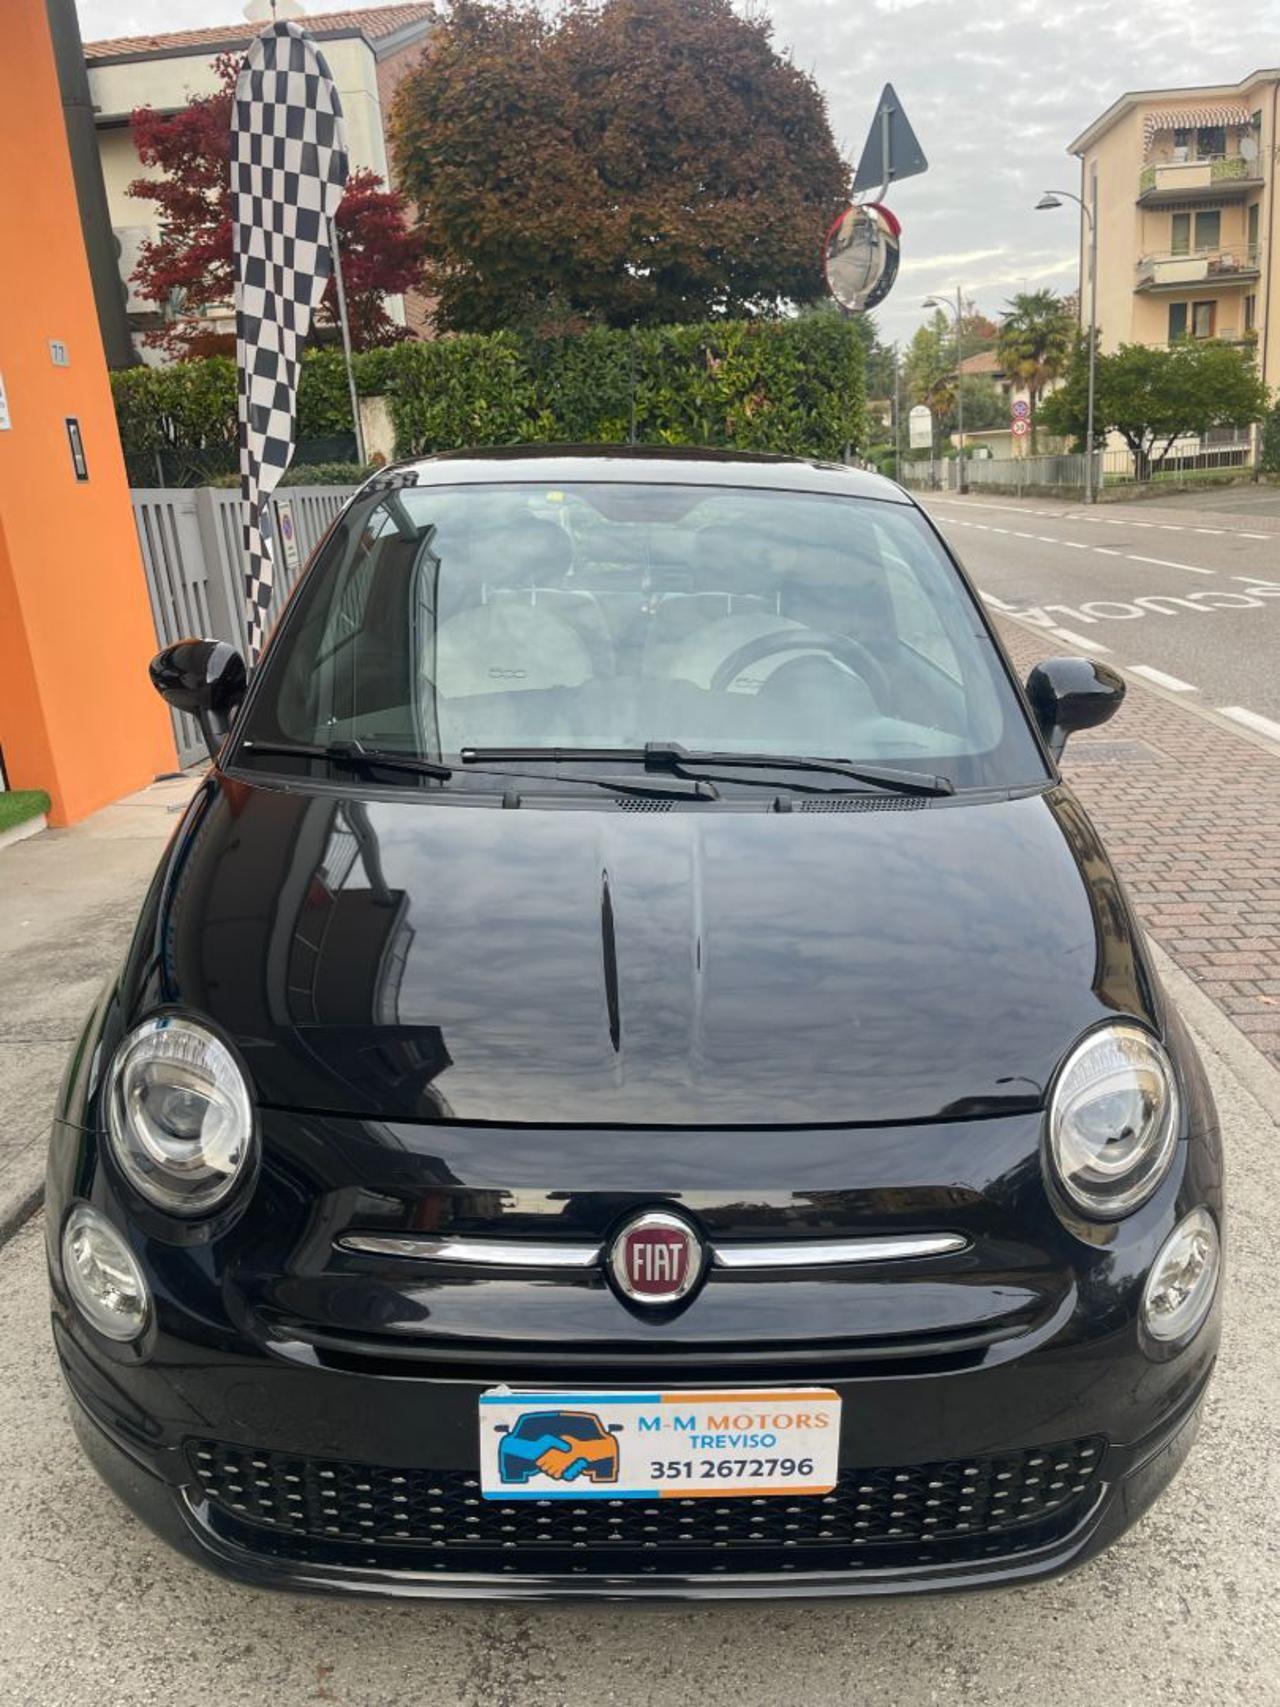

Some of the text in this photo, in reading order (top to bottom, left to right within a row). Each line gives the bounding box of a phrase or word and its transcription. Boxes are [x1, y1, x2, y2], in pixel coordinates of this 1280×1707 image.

[632, 1243, 684, 1281] FIAT
[637, 1412, 830, 1432] M-M MOTORS
[688, 1433, 777, 1449] TREVISO
